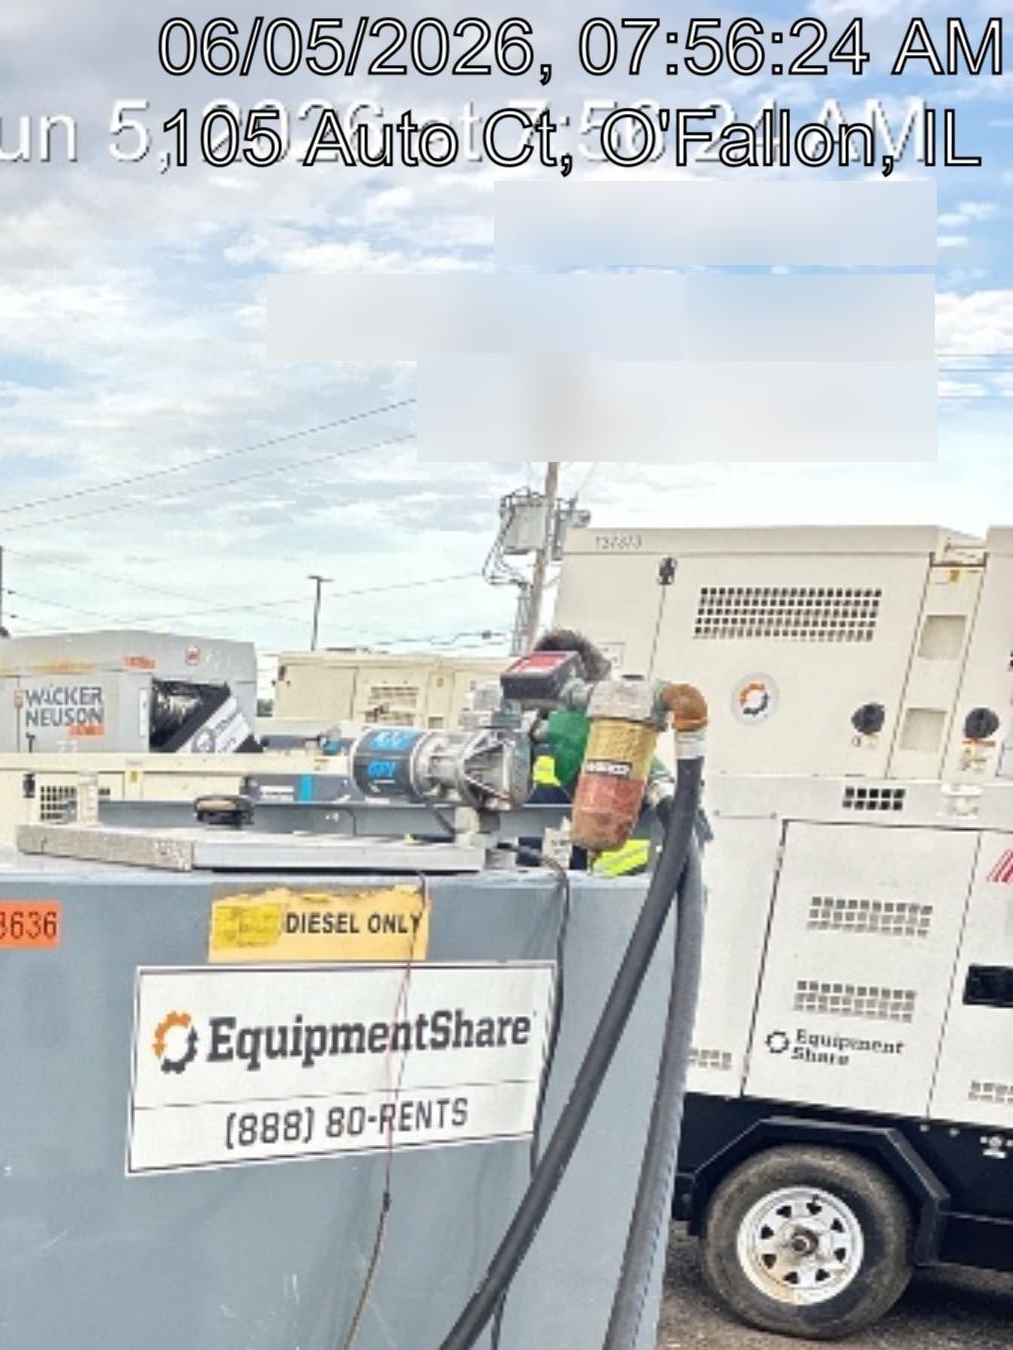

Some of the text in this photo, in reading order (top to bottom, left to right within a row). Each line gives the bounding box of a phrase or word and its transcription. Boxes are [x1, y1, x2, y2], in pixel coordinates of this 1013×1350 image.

[25, 686, 103, 707] WACKER
[25, 707, 105, 728] NEUSON
[284, 911, 361, 935] DIESEL
[367, 910, 424, 935] ONLY
[206, 1008, 532, 1072] EquipmentShare
[796, 1028, 905, 1055] Equipment
[790, 1046, 850, 1065] Share
[225, 1096, 470, 1150] (888) 80-RENTS
